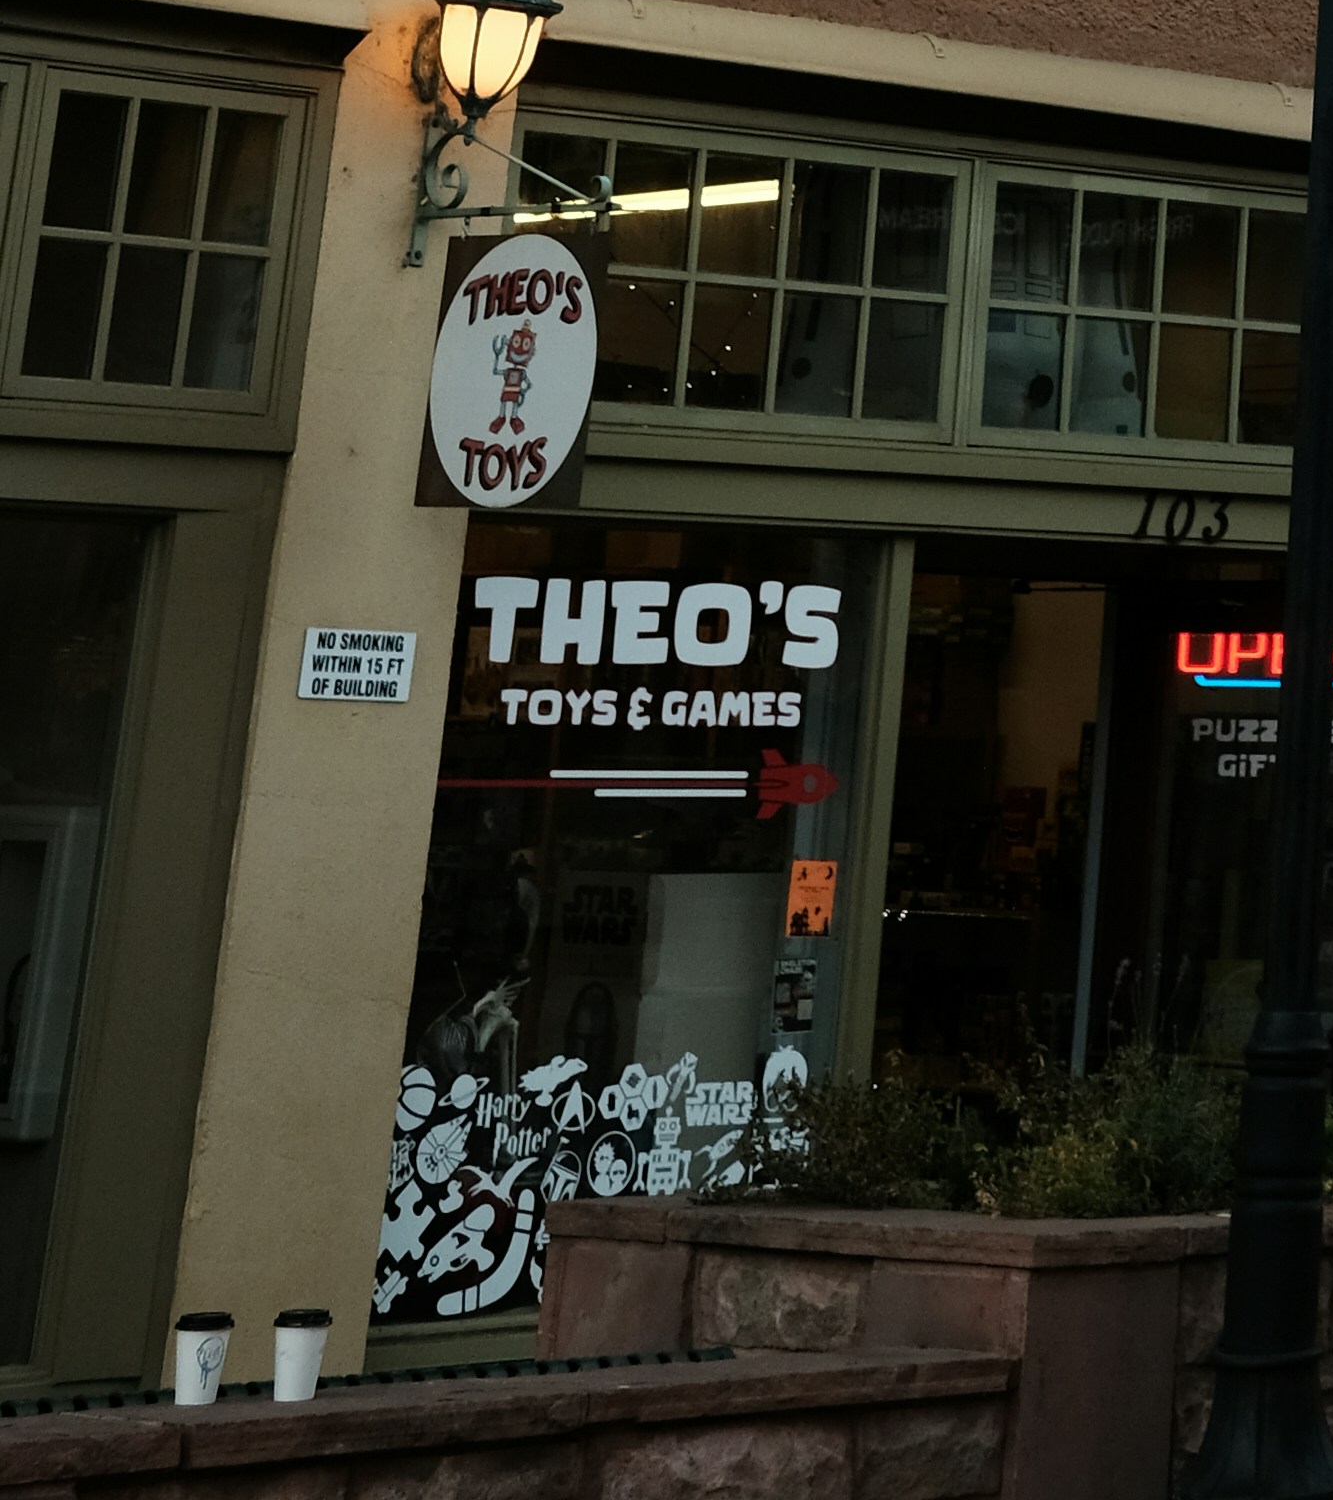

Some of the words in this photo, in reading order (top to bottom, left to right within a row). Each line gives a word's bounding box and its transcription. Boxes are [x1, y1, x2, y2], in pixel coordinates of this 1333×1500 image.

[463, 268, 583, 326] THEO'S
[458, 437, 548, 492] TOYS
[1132, 487, 1231, 544] 103
[317, 631, 337, 649] NO
[340, 632, 405, 652] SMOKING
[474, 576, 842, 669] THEO'S
[312, 654, 362, 674] WITHIN
[367, 657, 383, 675] 15
[387, 658, 405, 675] FT
[312, 677, 330, 695] OF
[333, 678, 398, 698] BUILDING
[501, 689, 618, 726] TOYS
[627, 687, 653, 731] &
[661, 690, 802, 728] GAMES
[475, 1092, 531, 1128] Harry
[685, 1081, 755, 1104] STAR
[685, 1103, 753, 1127] WARS
[493, 1121, 552, 1165] Potter
